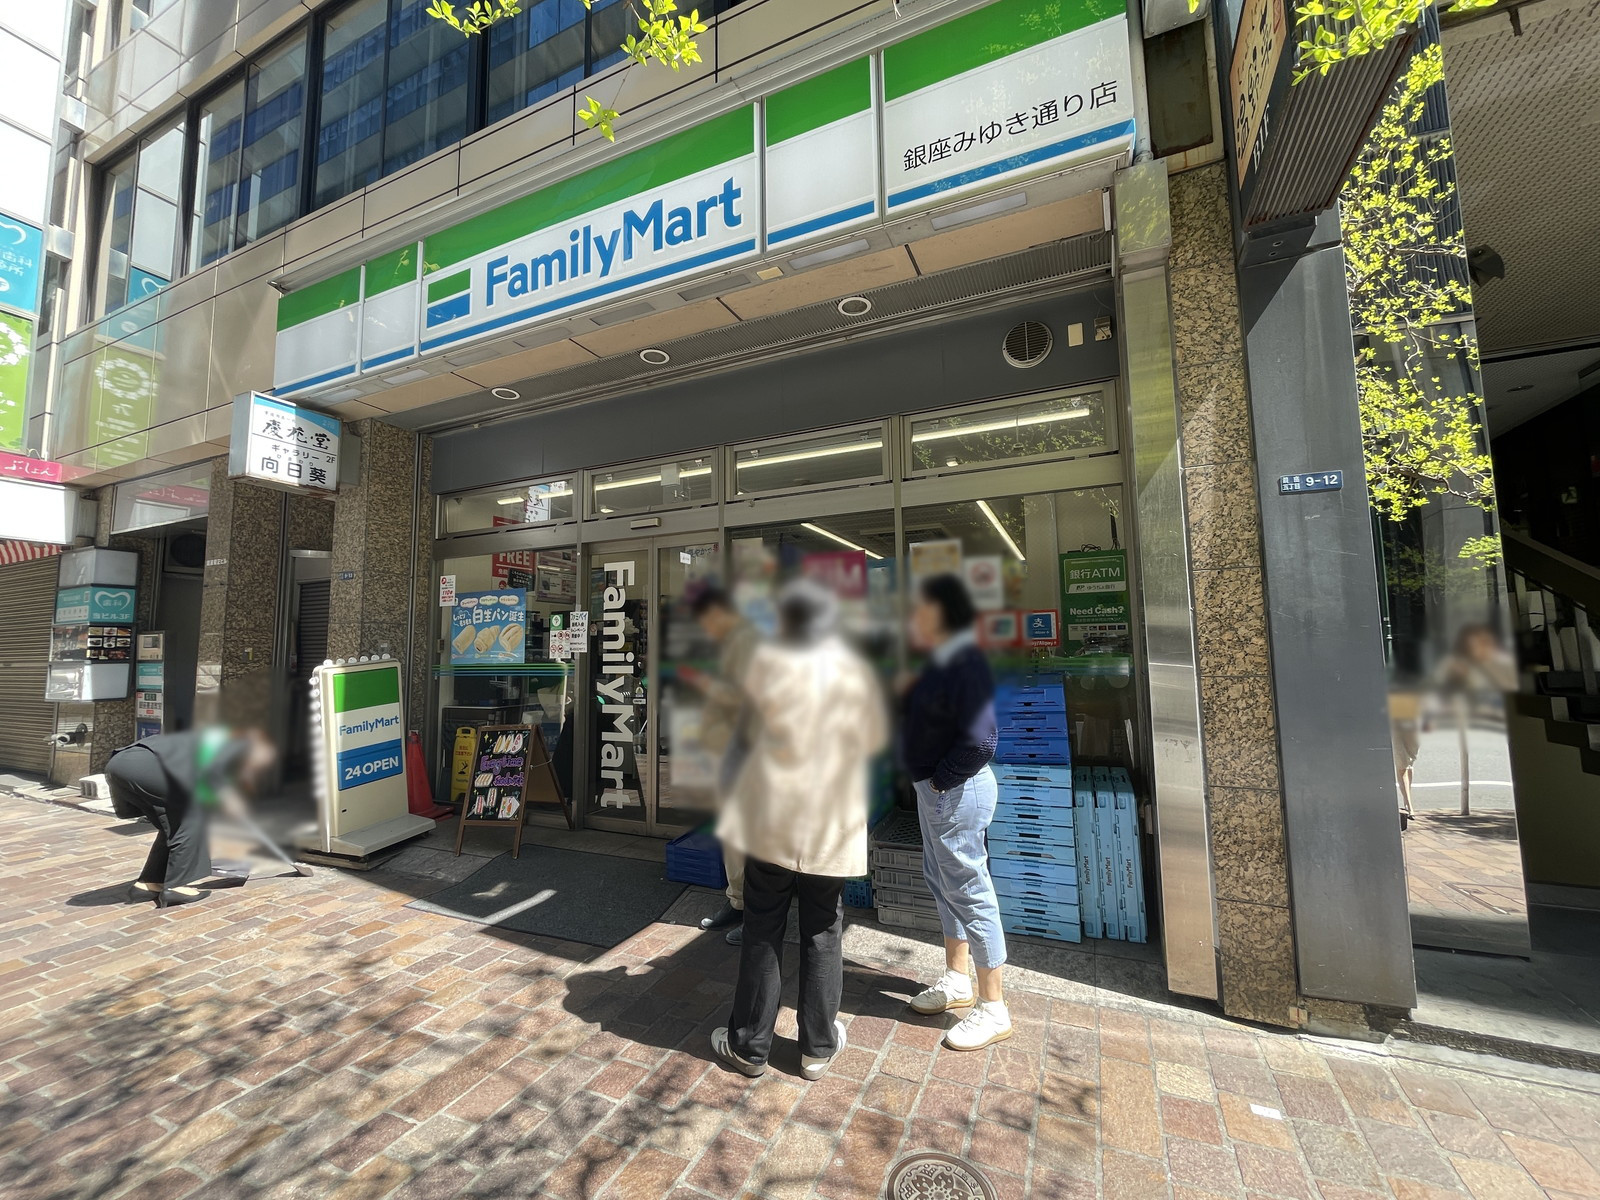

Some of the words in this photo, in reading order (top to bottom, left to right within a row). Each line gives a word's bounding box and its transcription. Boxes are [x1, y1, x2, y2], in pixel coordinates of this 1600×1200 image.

[903, 80, 1118, 172] 銀座みゆき通り店
[486, 176, 742, 307] FamilyMart
[271, 444, 320, 460] ギャラリー
[326, 455, 336, 464] 2F
[261, 456, 328, 485] 向日葵
[1305, 475, 1339, 487] 9-12
[1069, 567, 1121, 580] 銀行ATM
[1069, 607, 1093, 615] Need
[1094, 605, 1124, 615] Cash?
[596, 560, 635, 809] FamilyMart
[339, 715, 400, 736] FamilyMart
